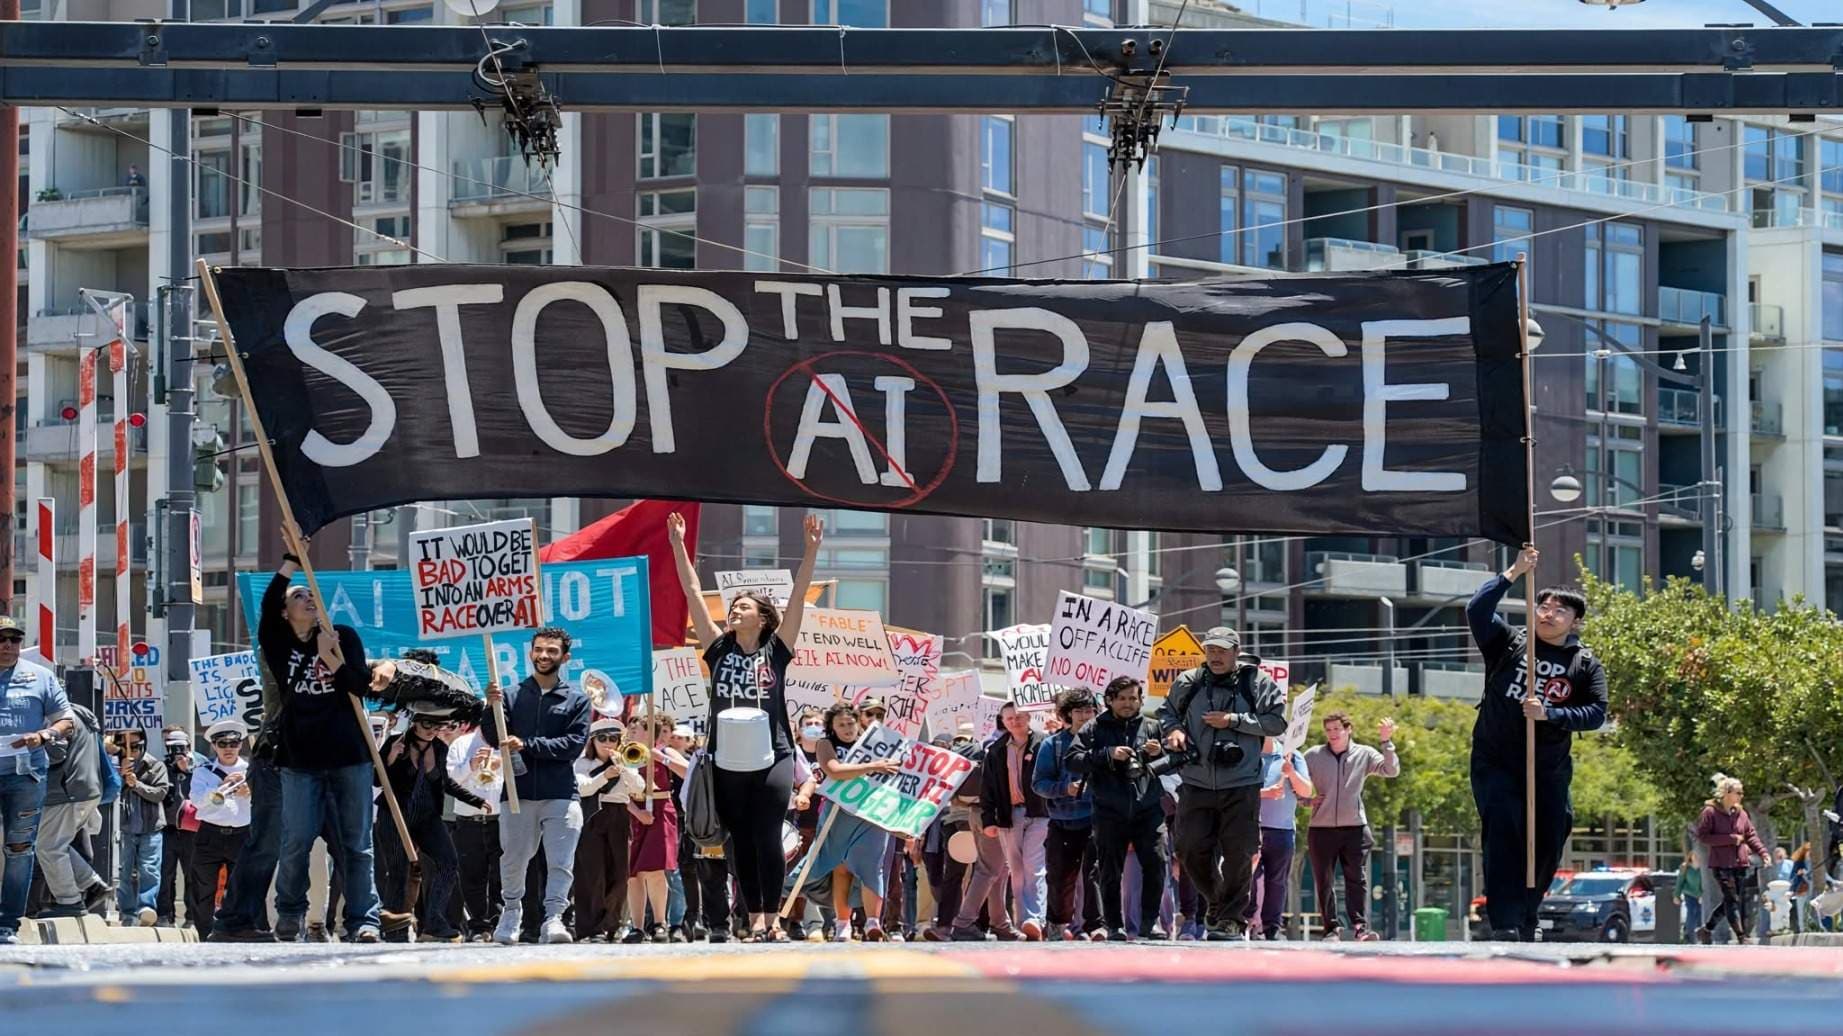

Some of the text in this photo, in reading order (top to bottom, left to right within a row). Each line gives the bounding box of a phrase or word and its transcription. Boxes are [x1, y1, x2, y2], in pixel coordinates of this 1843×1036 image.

[284, 280, 1471, 492] STOP THE AI RACE
[417, 529, 531, 561] IT WOULD BE
[418, 552, 531, 587] BAD TO GET
[327, 582, 383, 628] AI
[421, 576, 534, 608] INTO AN ARMS
[422, 595, 538, 634] RACE OVER AI
[1062, 597, 1154, 647] IN A RACE
[813, 633, 841, 645] END
[843, 636, 882, 651] WELL
[1002, 632, 1052, 651] WOUL
[1060, 626, 1097, 650] OFF
[1096, 637, 1107, 656] A
[1108, 640, 1150, 667] CLIFF
[660, 656, 697, 681] THE
[1007, 651, 1043, 670] MAKE
[1050, 656, 1071, 676] NO
[1075, 662, 1108, 687] ONE
[288, 679, 335, 695] ACE
[716, 683, 770, 699] RACE
[904, 743, 971, 780] STOP
